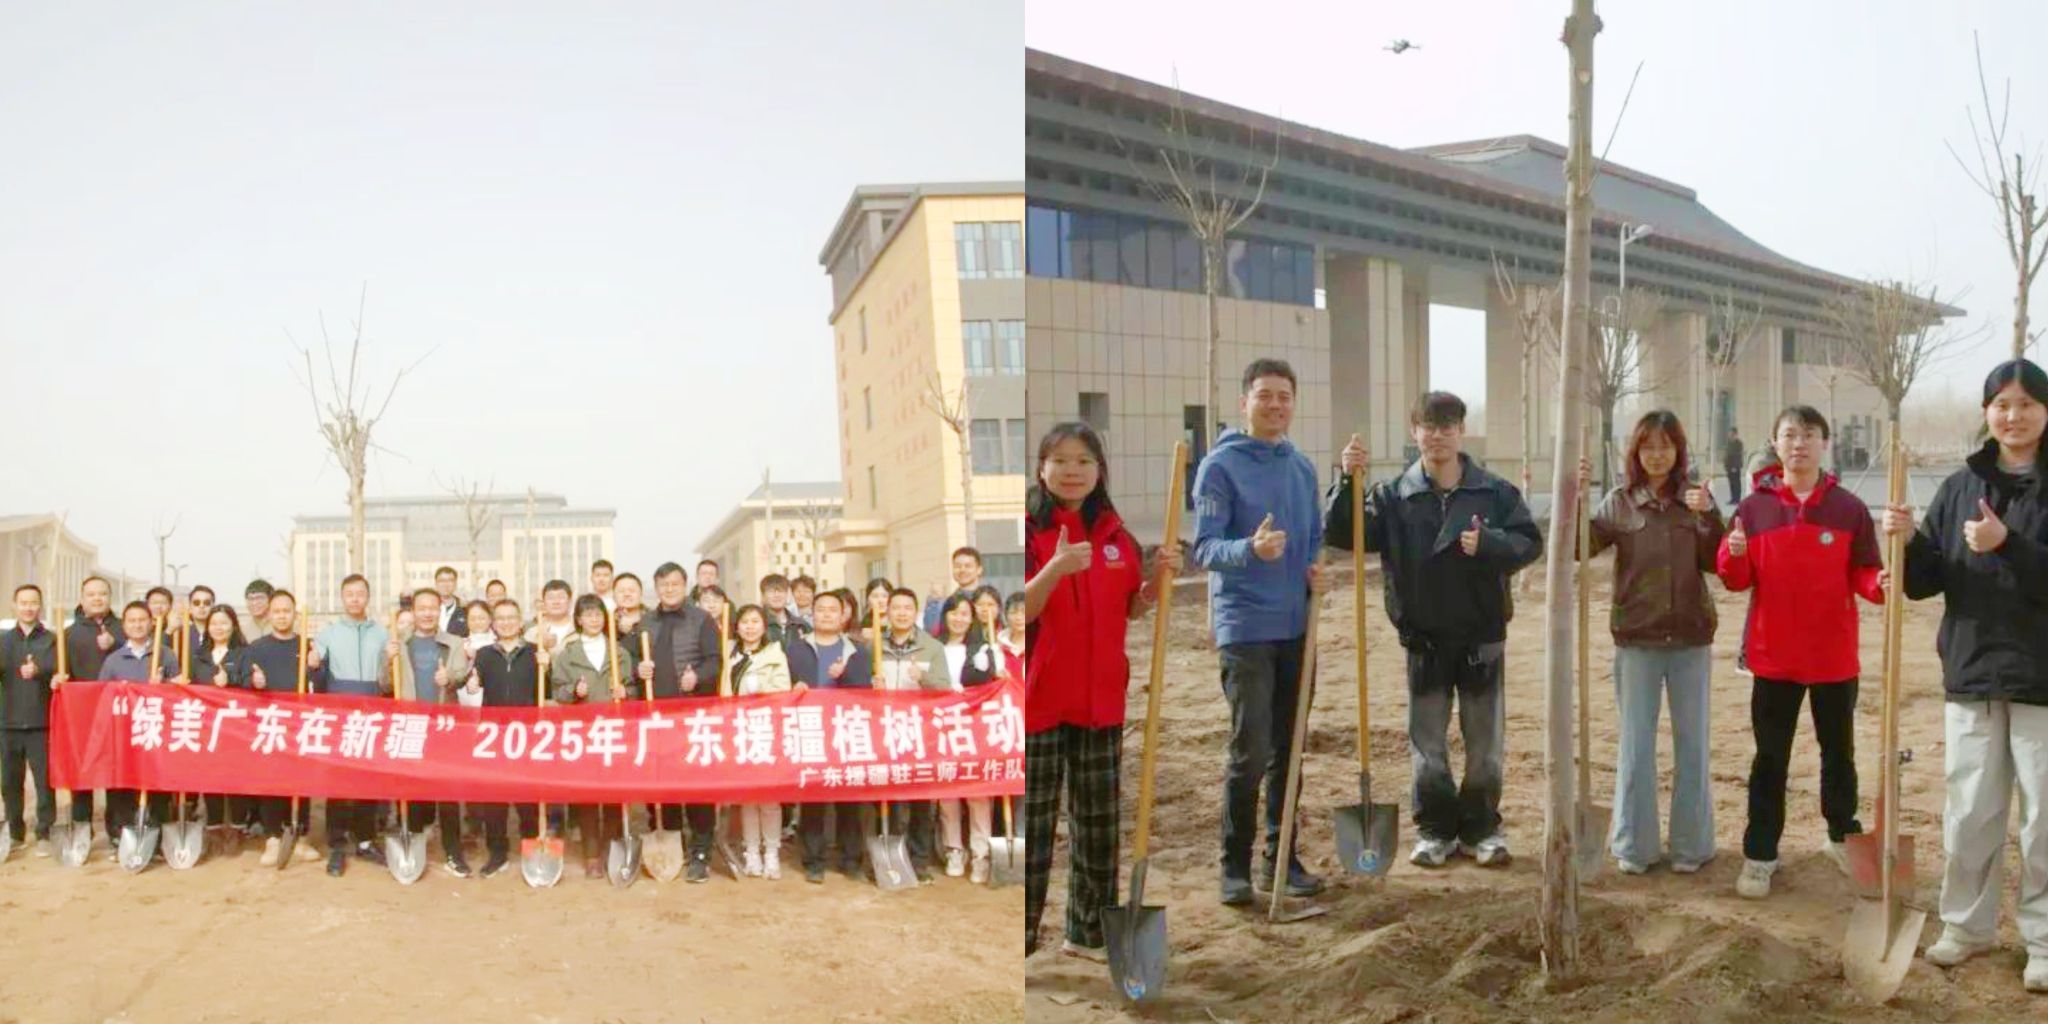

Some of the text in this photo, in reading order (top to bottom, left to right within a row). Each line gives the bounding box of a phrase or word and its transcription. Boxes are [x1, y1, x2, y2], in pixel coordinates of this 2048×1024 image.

[473, 694, 1024, 766] 2025年广东援疆植树活动
[799, 758, 1024, 788] 广东援疆驻三师工作队
